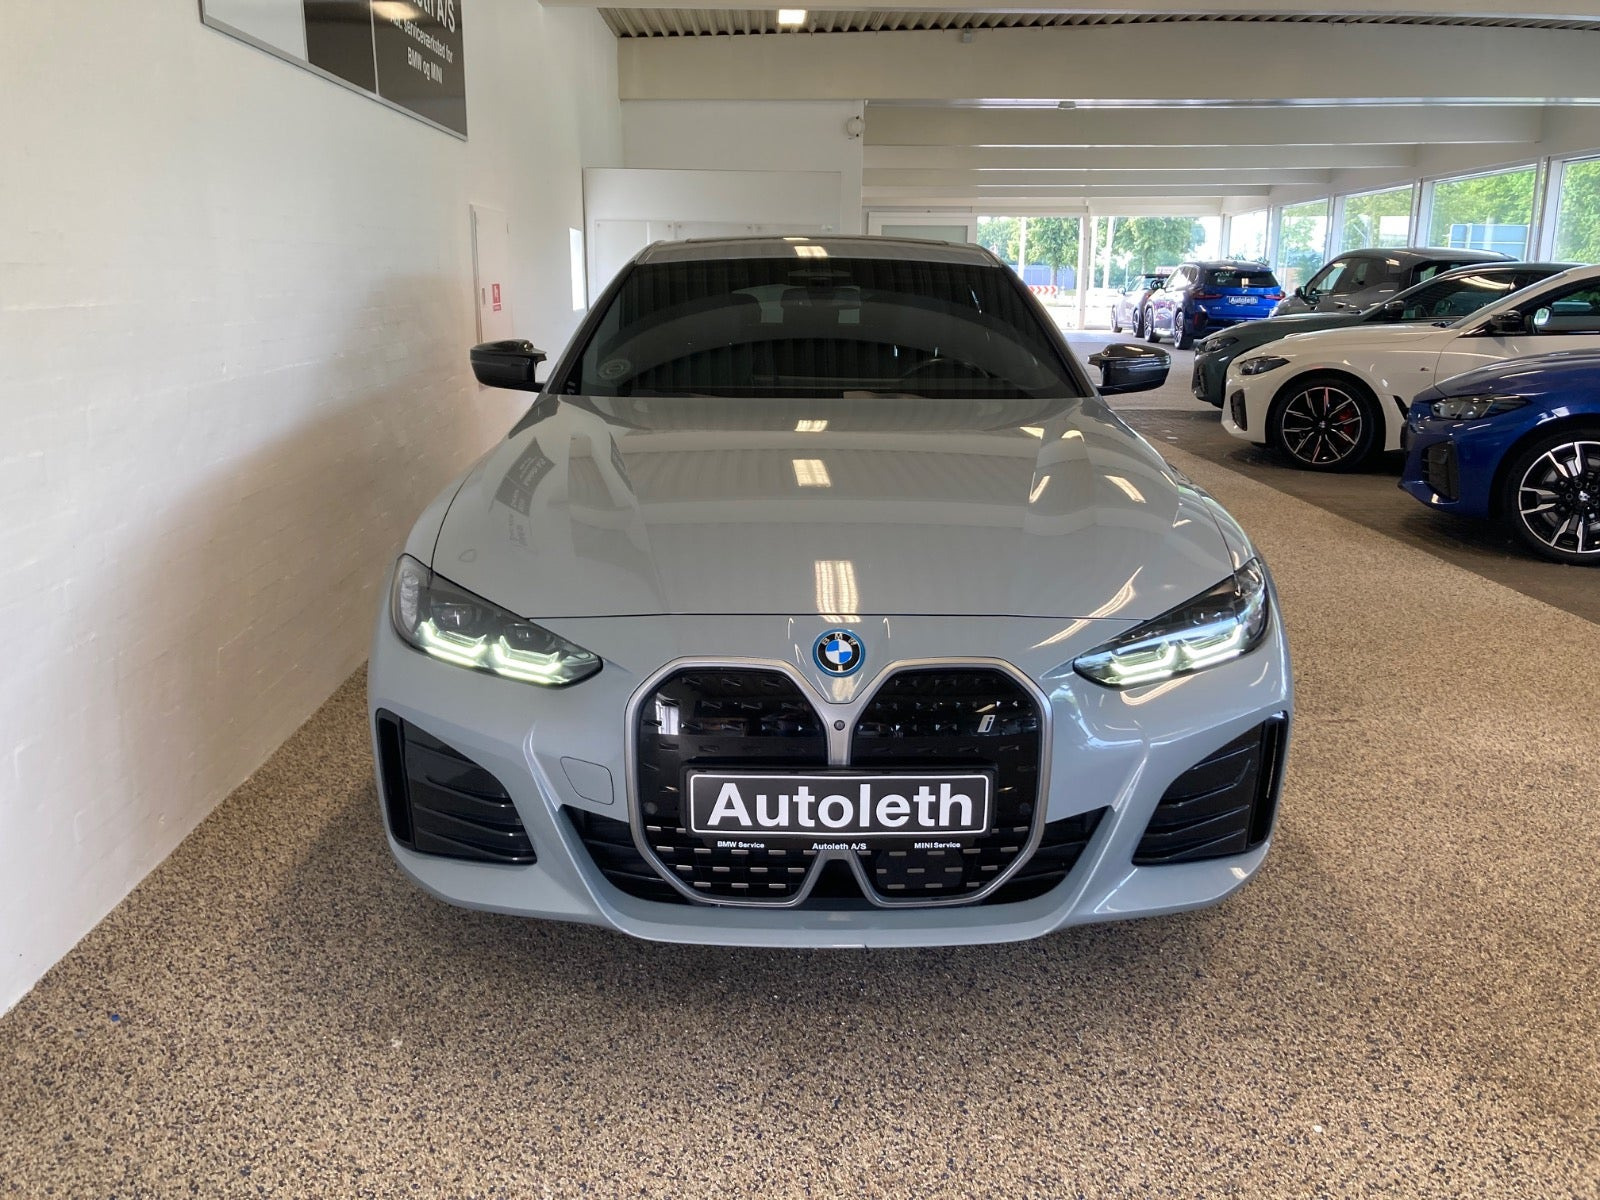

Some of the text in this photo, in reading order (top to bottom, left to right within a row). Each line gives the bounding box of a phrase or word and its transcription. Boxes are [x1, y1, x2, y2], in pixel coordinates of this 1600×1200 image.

[437, 0, 455, 32] A/S
[408, 46, 442, 84] BMW og MINI
[821, 633, 858, 645] BMW
[706, 782, 972, 828] Autoleth
